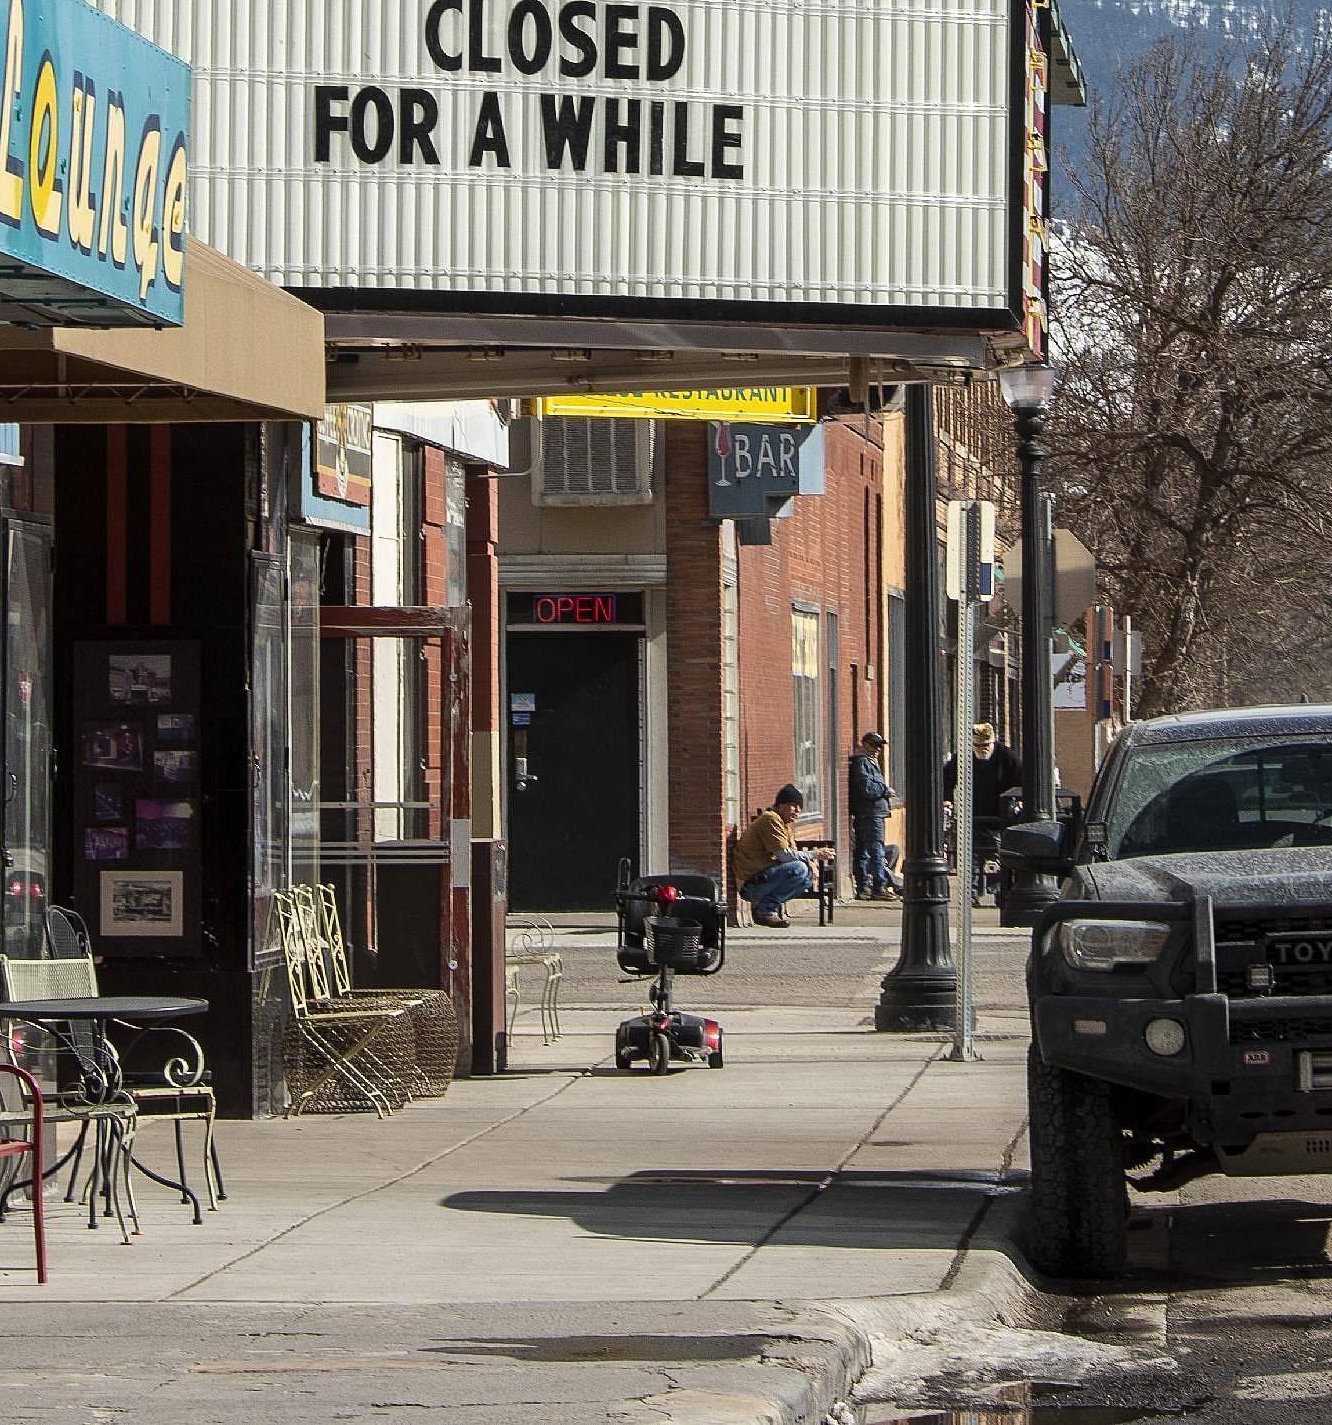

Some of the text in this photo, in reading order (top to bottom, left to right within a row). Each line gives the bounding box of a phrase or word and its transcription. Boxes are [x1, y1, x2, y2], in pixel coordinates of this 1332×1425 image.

[314, 85, 744, 179] FOR A WHILE
[734, 432, 797, 478] BAR
[536, 595, 613, 623] OPEN
